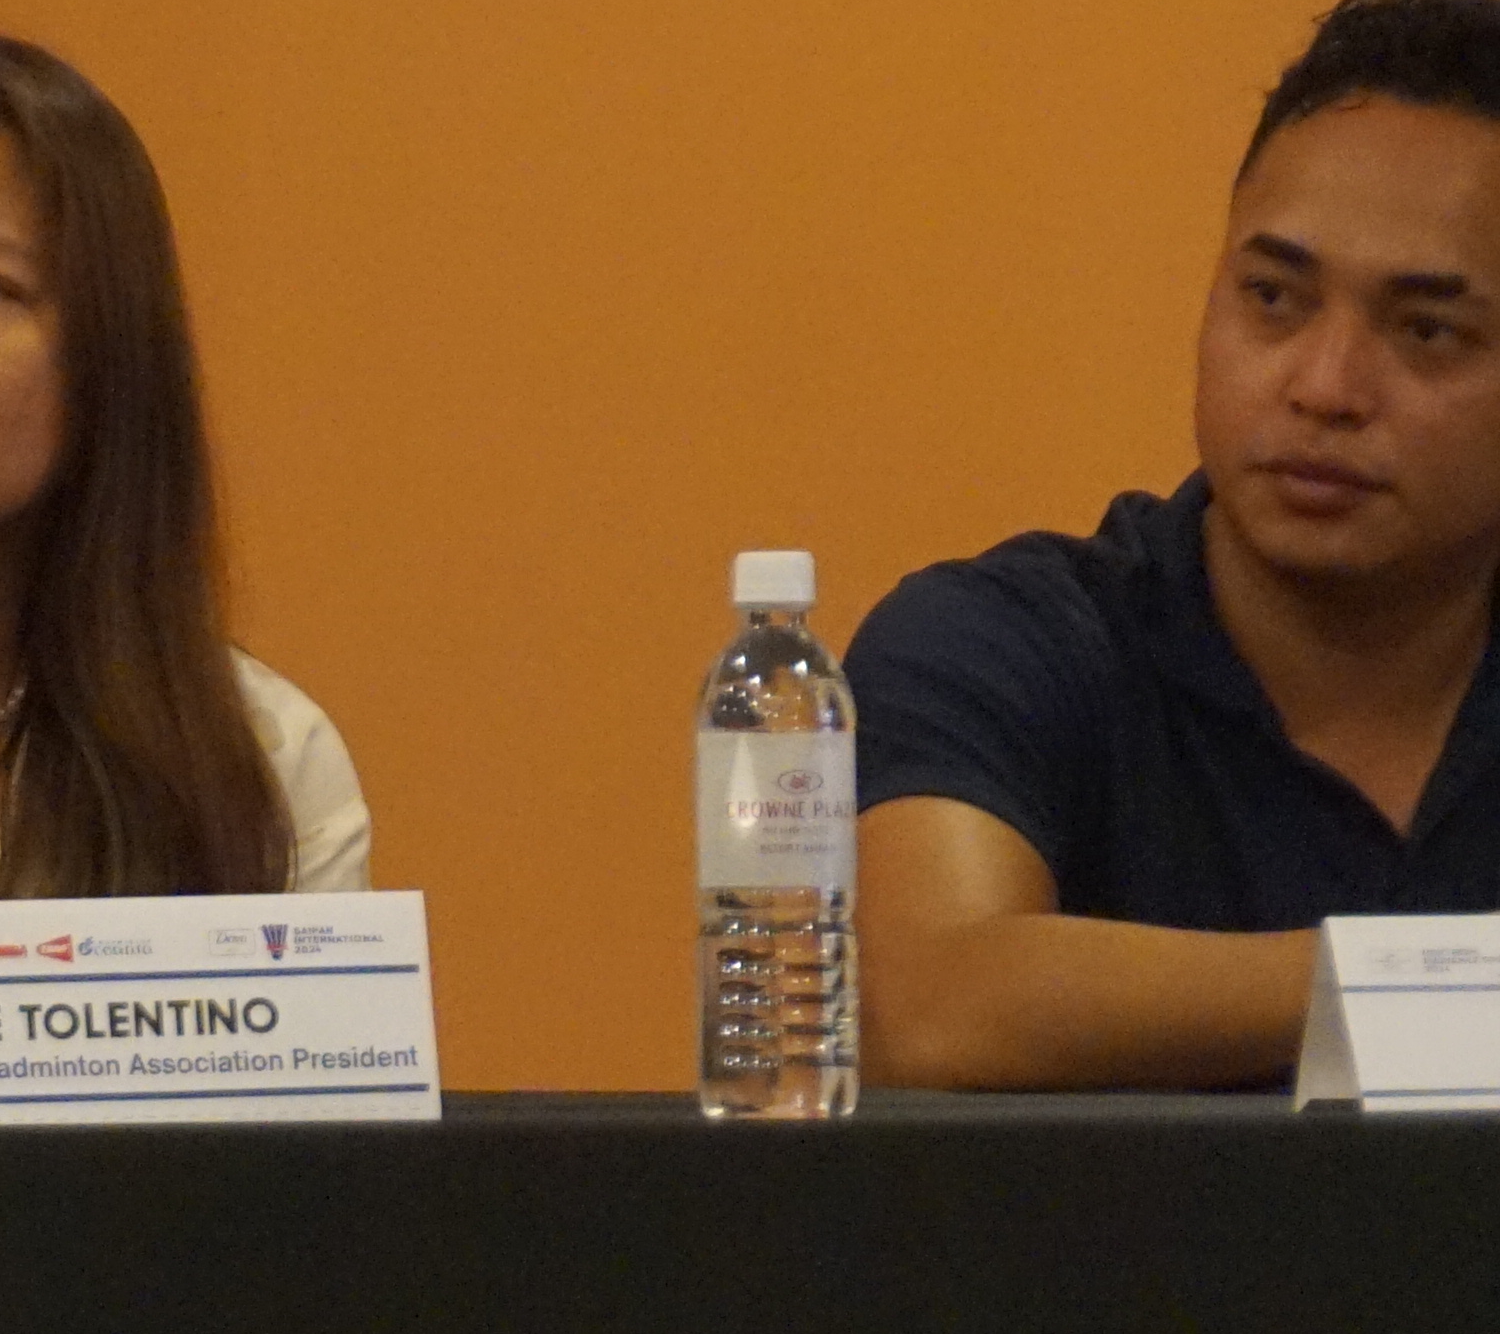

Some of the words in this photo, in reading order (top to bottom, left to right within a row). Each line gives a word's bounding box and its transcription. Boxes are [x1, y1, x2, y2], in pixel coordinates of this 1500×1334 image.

[18, 996, 280, 1041] TOLENTINO
[129, 1049, 285, 1076] Association
[292, 1044, 419, 1071] President
